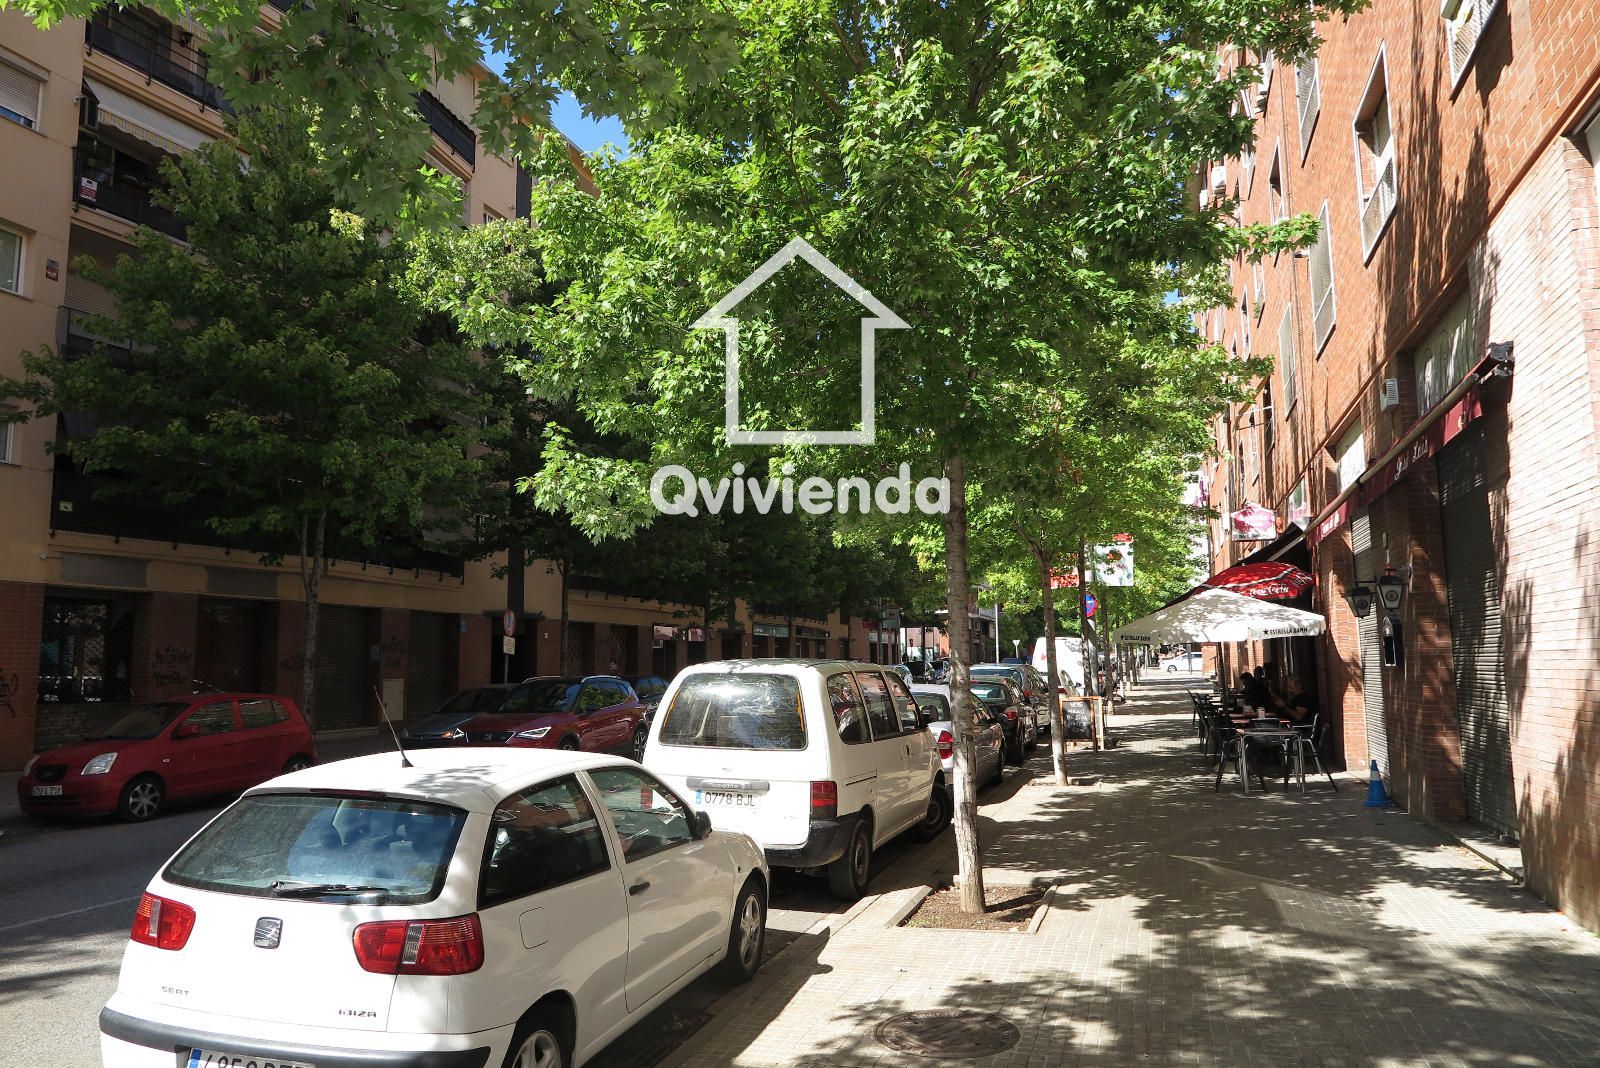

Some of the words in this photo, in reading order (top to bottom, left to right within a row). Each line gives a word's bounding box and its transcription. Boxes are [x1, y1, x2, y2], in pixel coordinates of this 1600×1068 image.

[705, 792, 732, 804] 0778
[737, 794, 755, 806] BJL
[161, 986, 189, 996] SEAT
[338, 1009, 377, 1018] IBIZA
